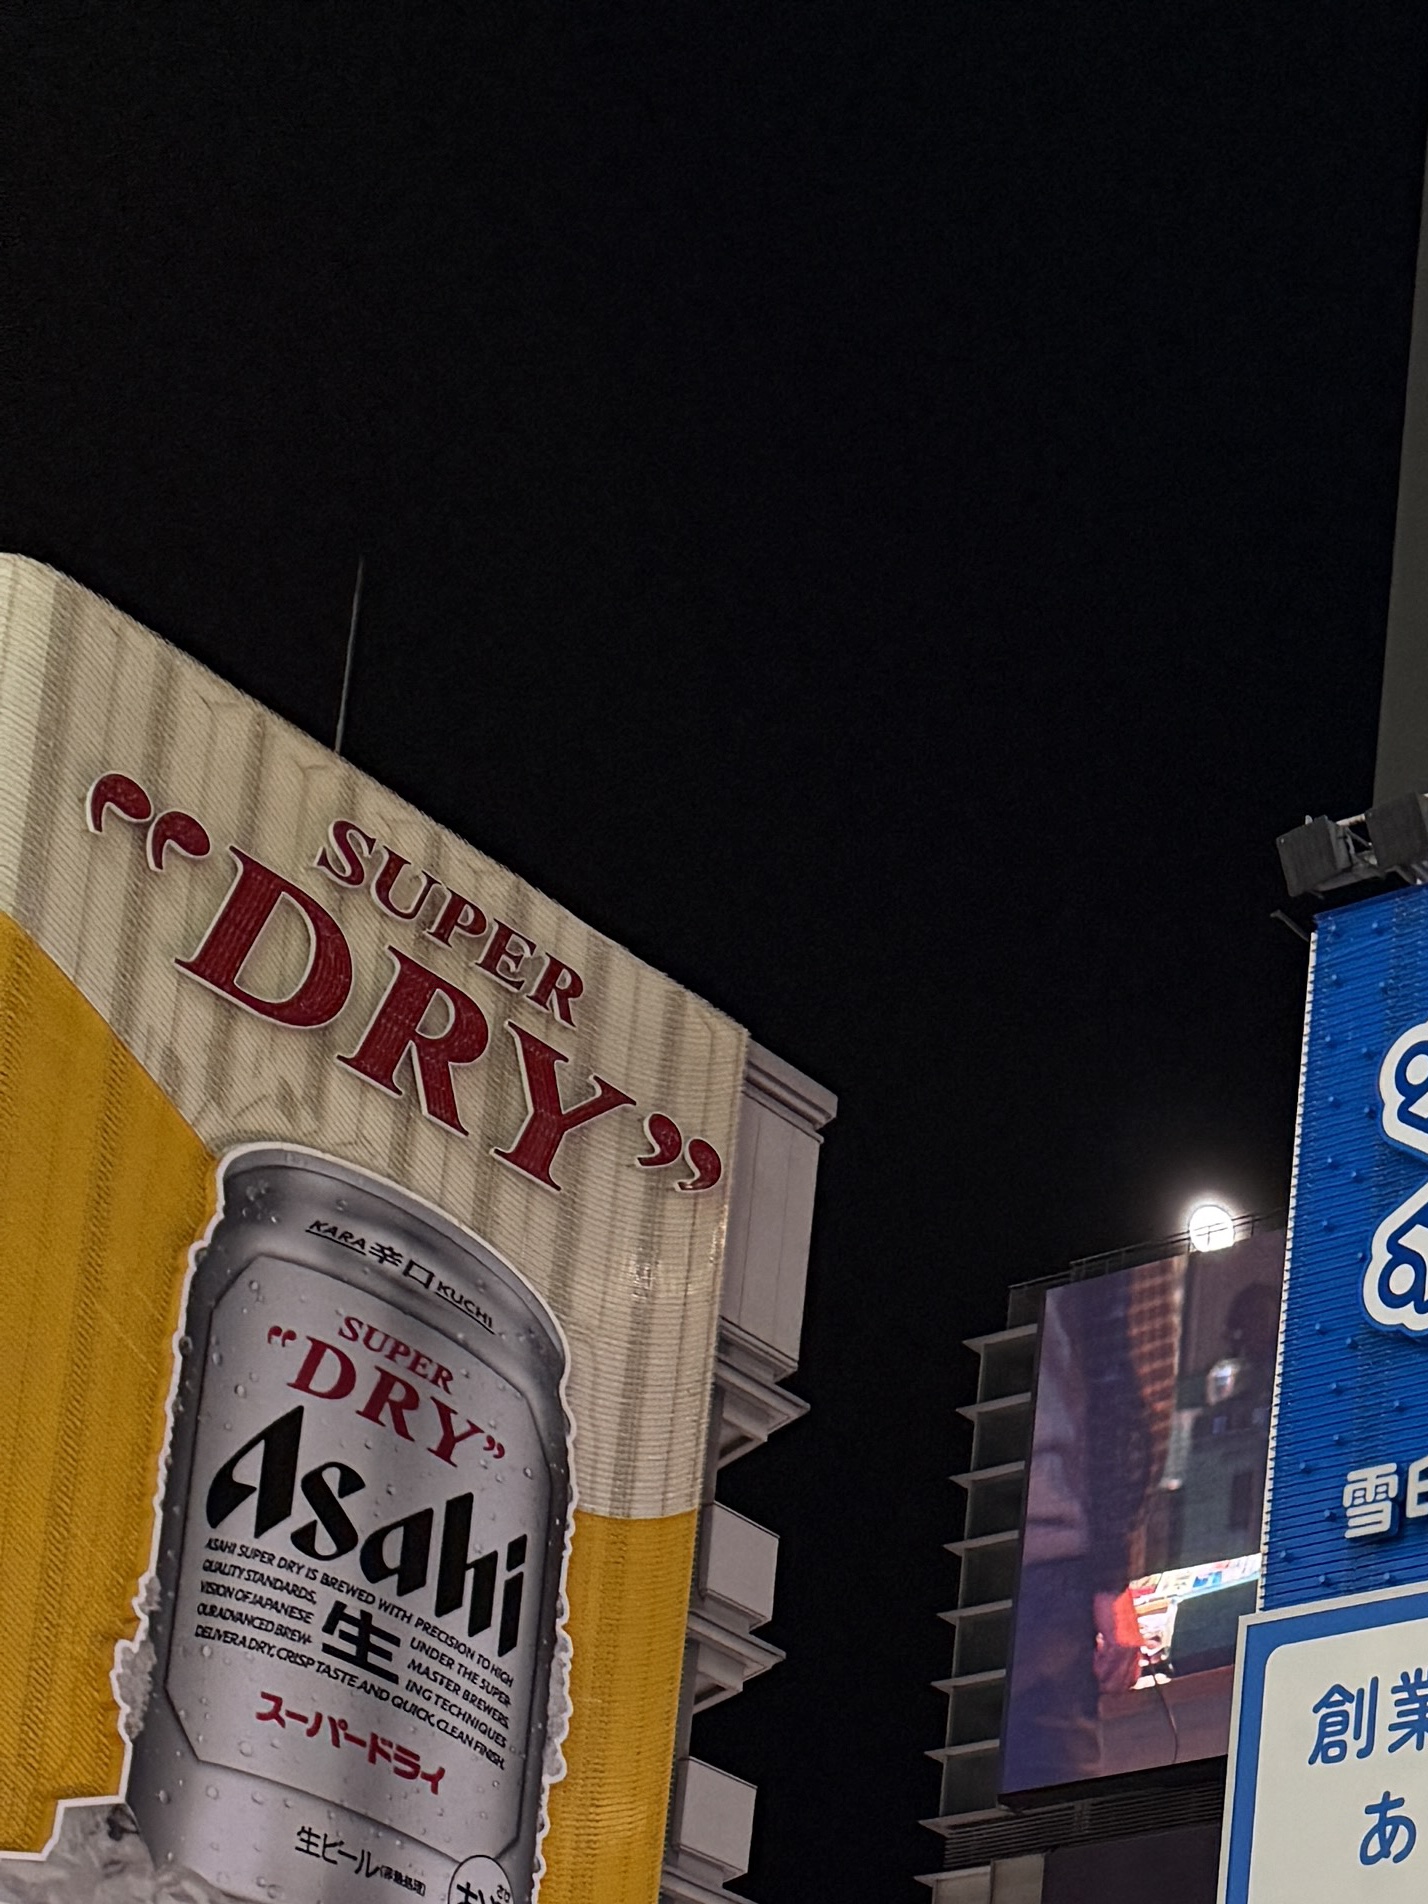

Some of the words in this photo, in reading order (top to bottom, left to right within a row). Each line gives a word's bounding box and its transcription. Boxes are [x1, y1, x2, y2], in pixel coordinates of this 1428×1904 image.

[316, 819, 585, 1027] SUPER
[308, 1220, 366, 1250] KARA
[369, 1242, 435, 1288] 辛口
[436, 1281, 494, 1328] KUCHI
[338, 1316, 453, 1394] SUPER
[205, 1405, 528, 1659] Asahi
[237, 1544, 276, 1566] SUPER
[277, 1556, 305, 1575] DRY
[305, 1567, 319, 1581] IS
[320, 1572, 376, 1605] BREWED
[377, 1598, 413, 1625] WITH
[414, 1617, 476, 1661] PRECISION
[475, 1653, 491, 1670] TO
[249, 1593, 315, 1625] JAPANESE
[406, 1658, 462, 1696] MASTER
[321, 1599, 401, 1686] 生
[276, 1647, 316, 1668] CRISP
[315, 1660, 359, 1688] TASTE
[357, 1680, 390, 1701] AND
[436, 1718, 475, 1748] CLEAN
[410, 1636, 455, 1671] UNDER
[457, 1662, 482, 1685] THE
[253, 1690, 448, 1797] スーパードライ
[405, 1679, 434, 1702] ING
[433, 1693, 508, 1750] TECHNIQUES
